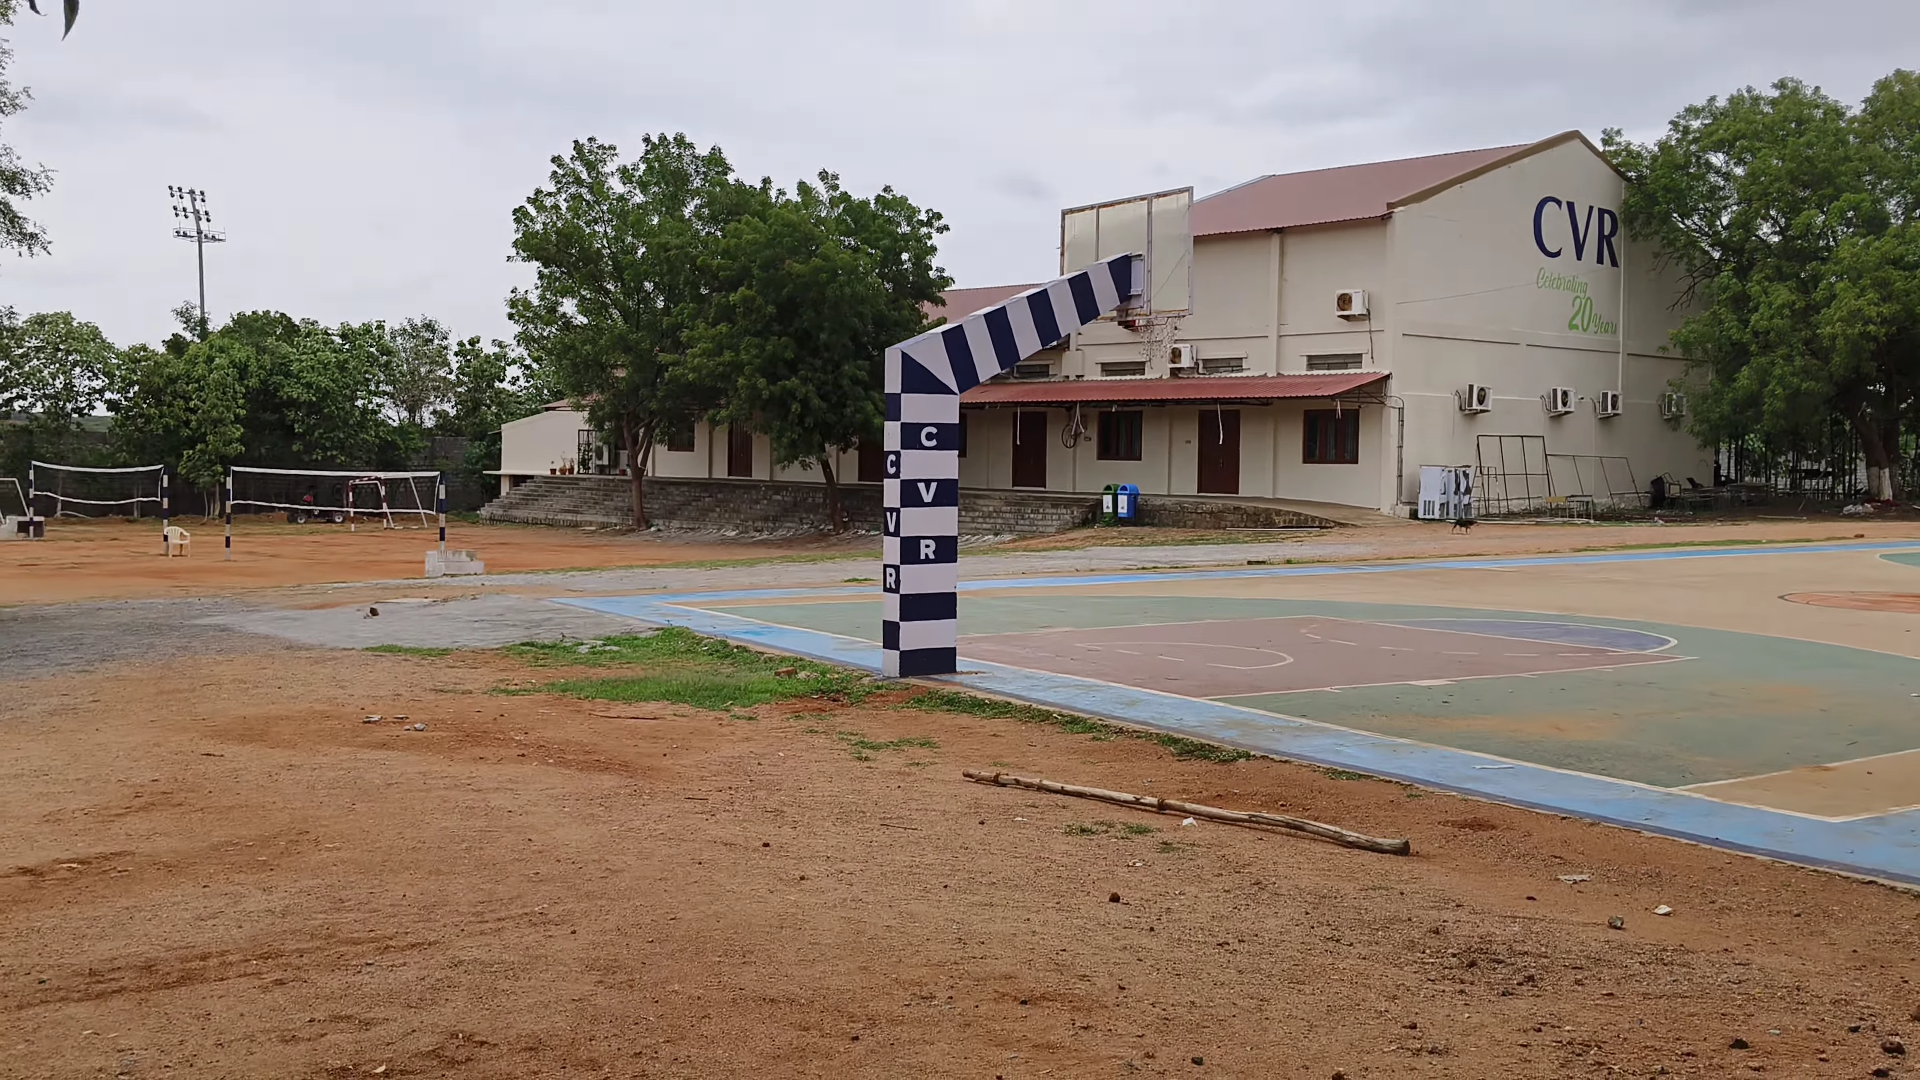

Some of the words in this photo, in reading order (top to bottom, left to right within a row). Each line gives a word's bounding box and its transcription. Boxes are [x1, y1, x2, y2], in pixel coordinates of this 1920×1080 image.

[1533, 196, 1619, 268] CVR
[1537, 267, 1588, 299] Celebrating
[1568, 295, 1594, 333] 20
[1592, 313, 1617, 334] Years
